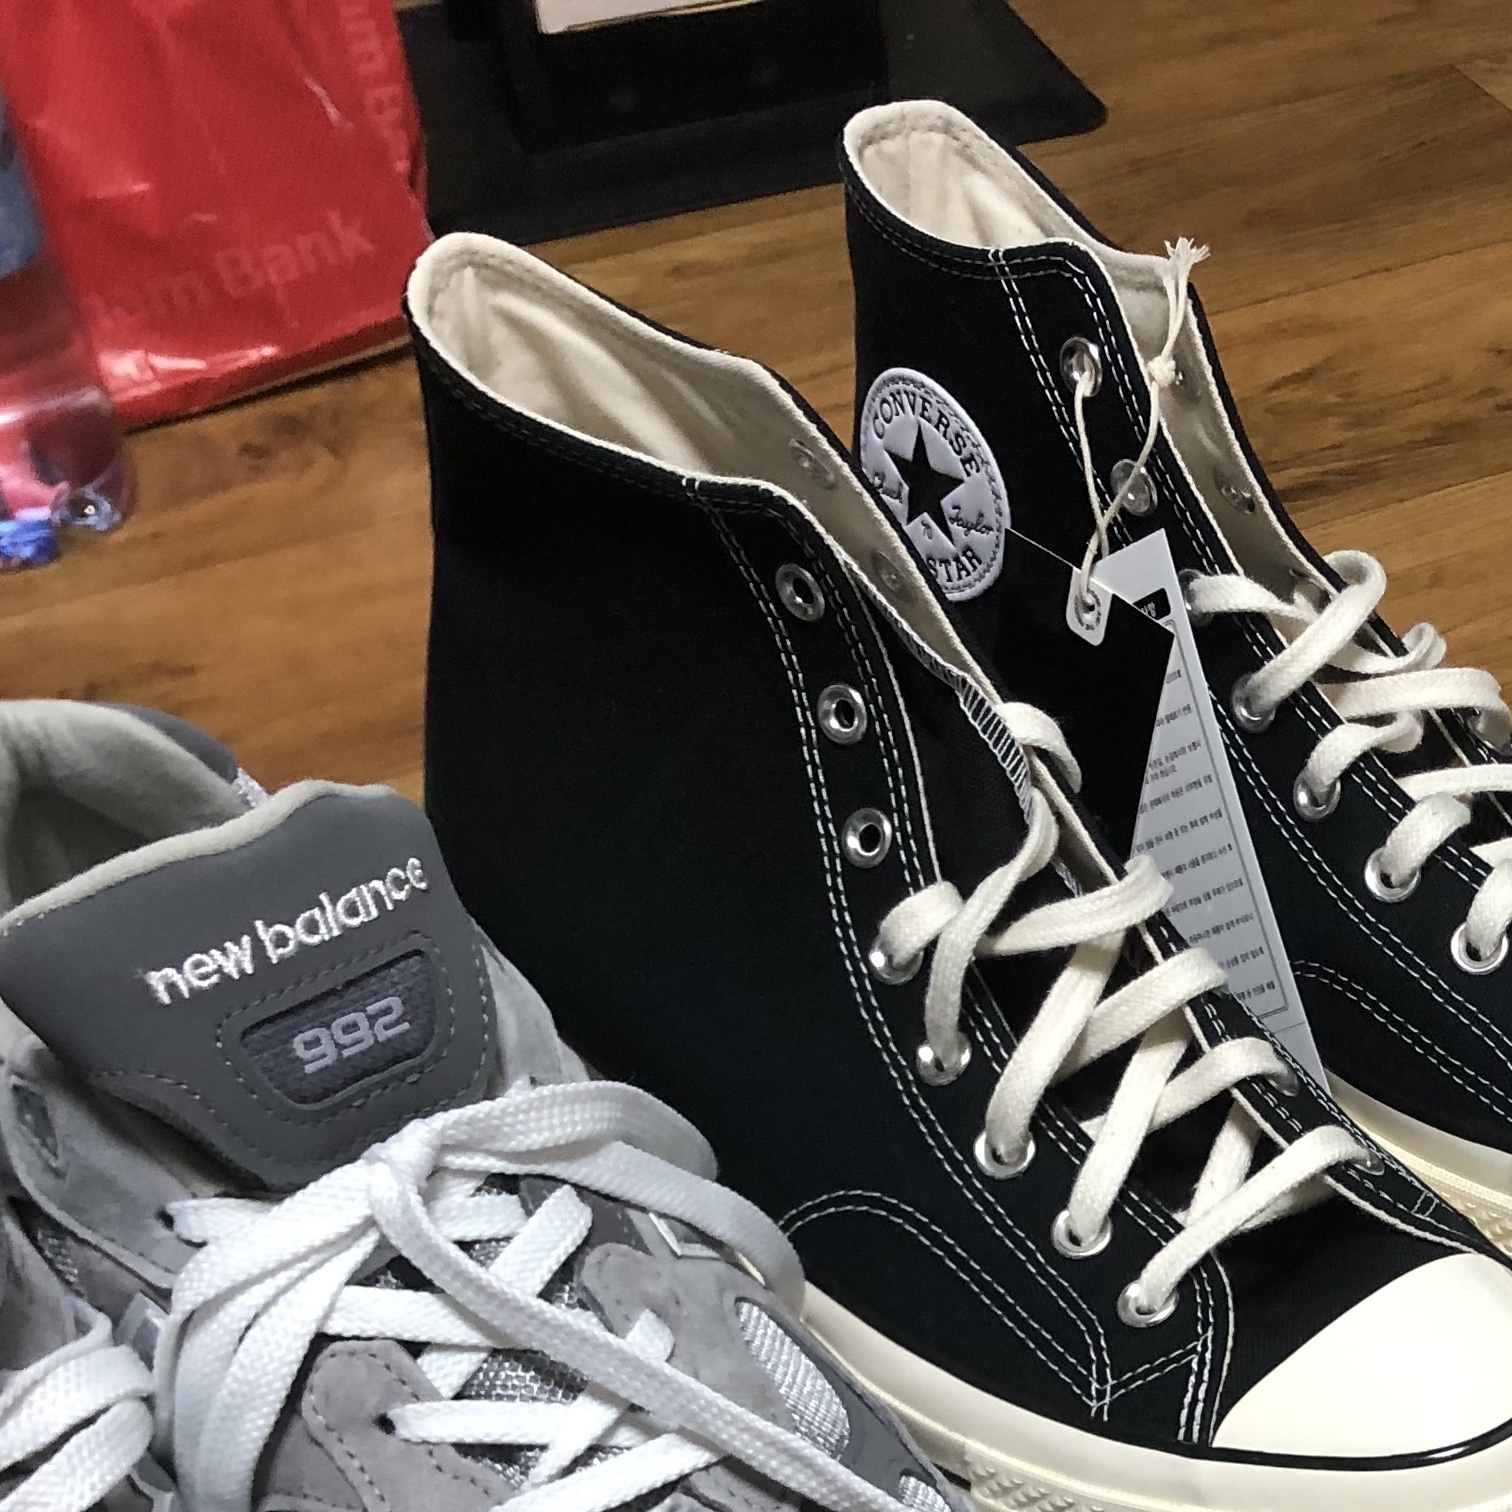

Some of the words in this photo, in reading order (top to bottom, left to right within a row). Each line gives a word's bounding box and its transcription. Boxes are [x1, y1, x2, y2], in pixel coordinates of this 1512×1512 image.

[213, 210, 376, 299] Bank
[872, 388, 982, 478] CONVERSE
[925, 545, 983, 583] STAR
[145, 934, 255, 1005] new
[255, 857, 428, 964] balance
[292, 996, 410, 1074] 992
